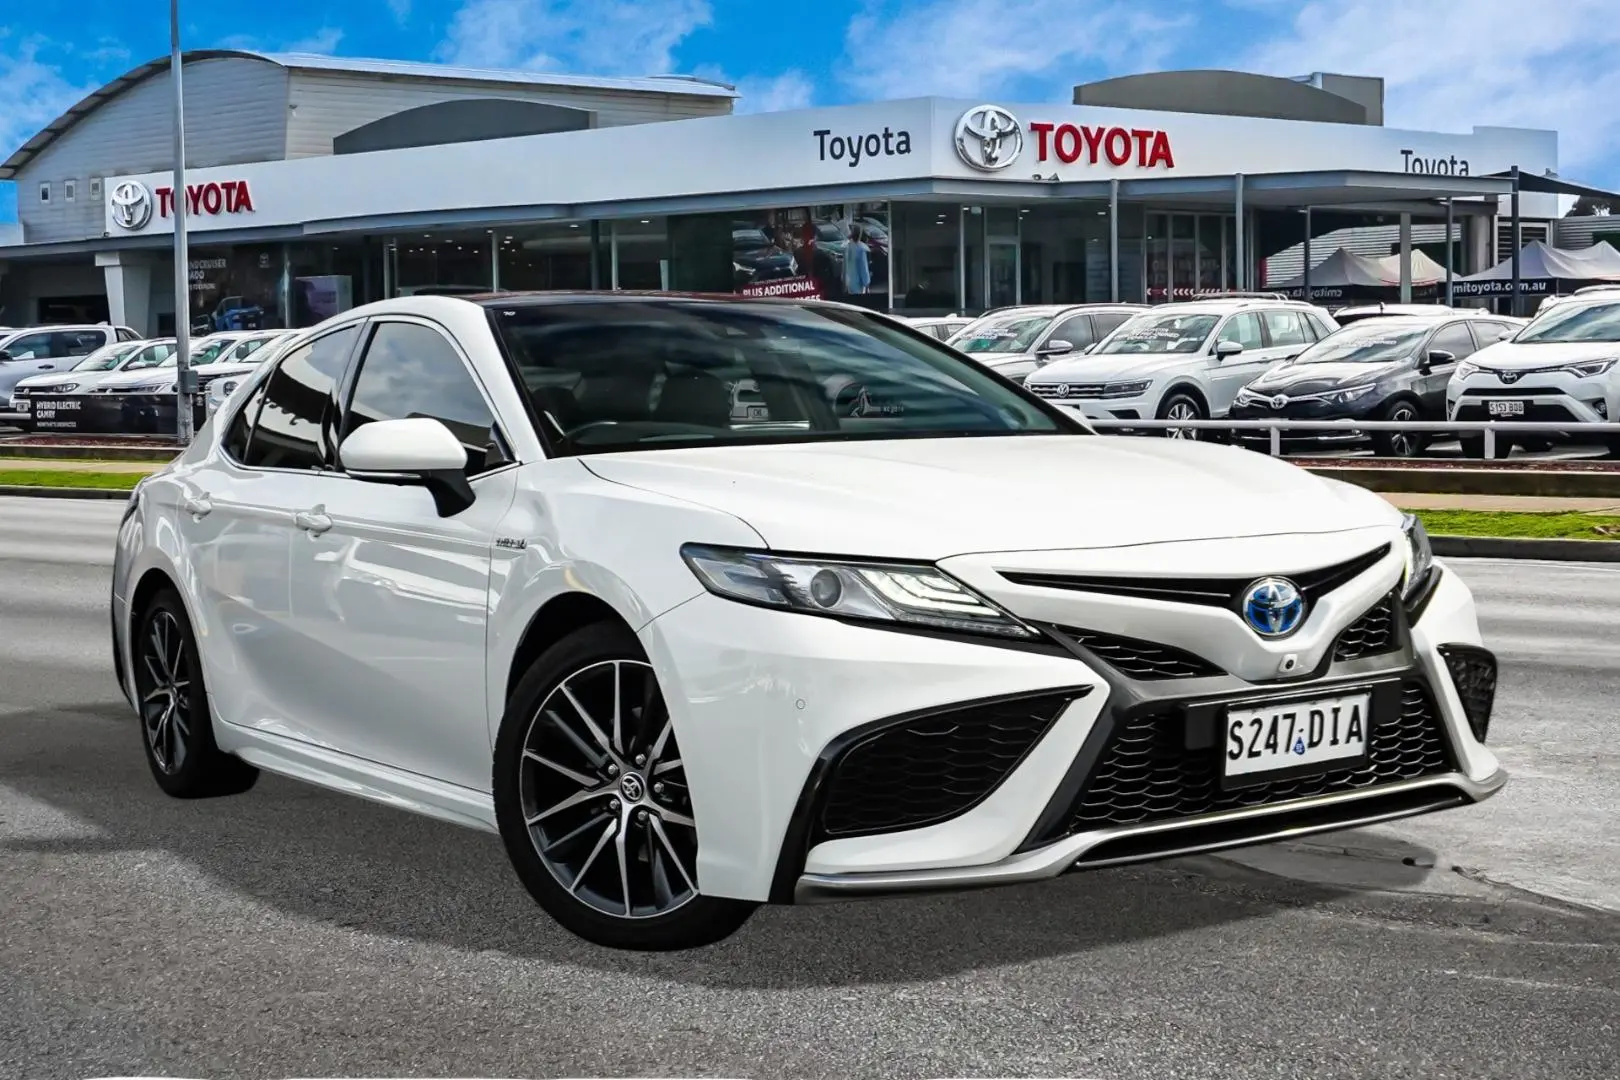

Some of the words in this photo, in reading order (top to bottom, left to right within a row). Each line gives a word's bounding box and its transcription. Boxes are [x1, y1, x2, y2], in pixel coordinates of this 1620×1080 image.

[813, 127, 912, 168] Toyota
[1030, 122, 1175, 168] TOYOTA
[764, 280, 816, 297] ADDITIONAL
[57, 401, 82, 410] ELECTRIC
[1227, 712, 1297, 761] S247
[1307, 704, 1364, 749] DIA
